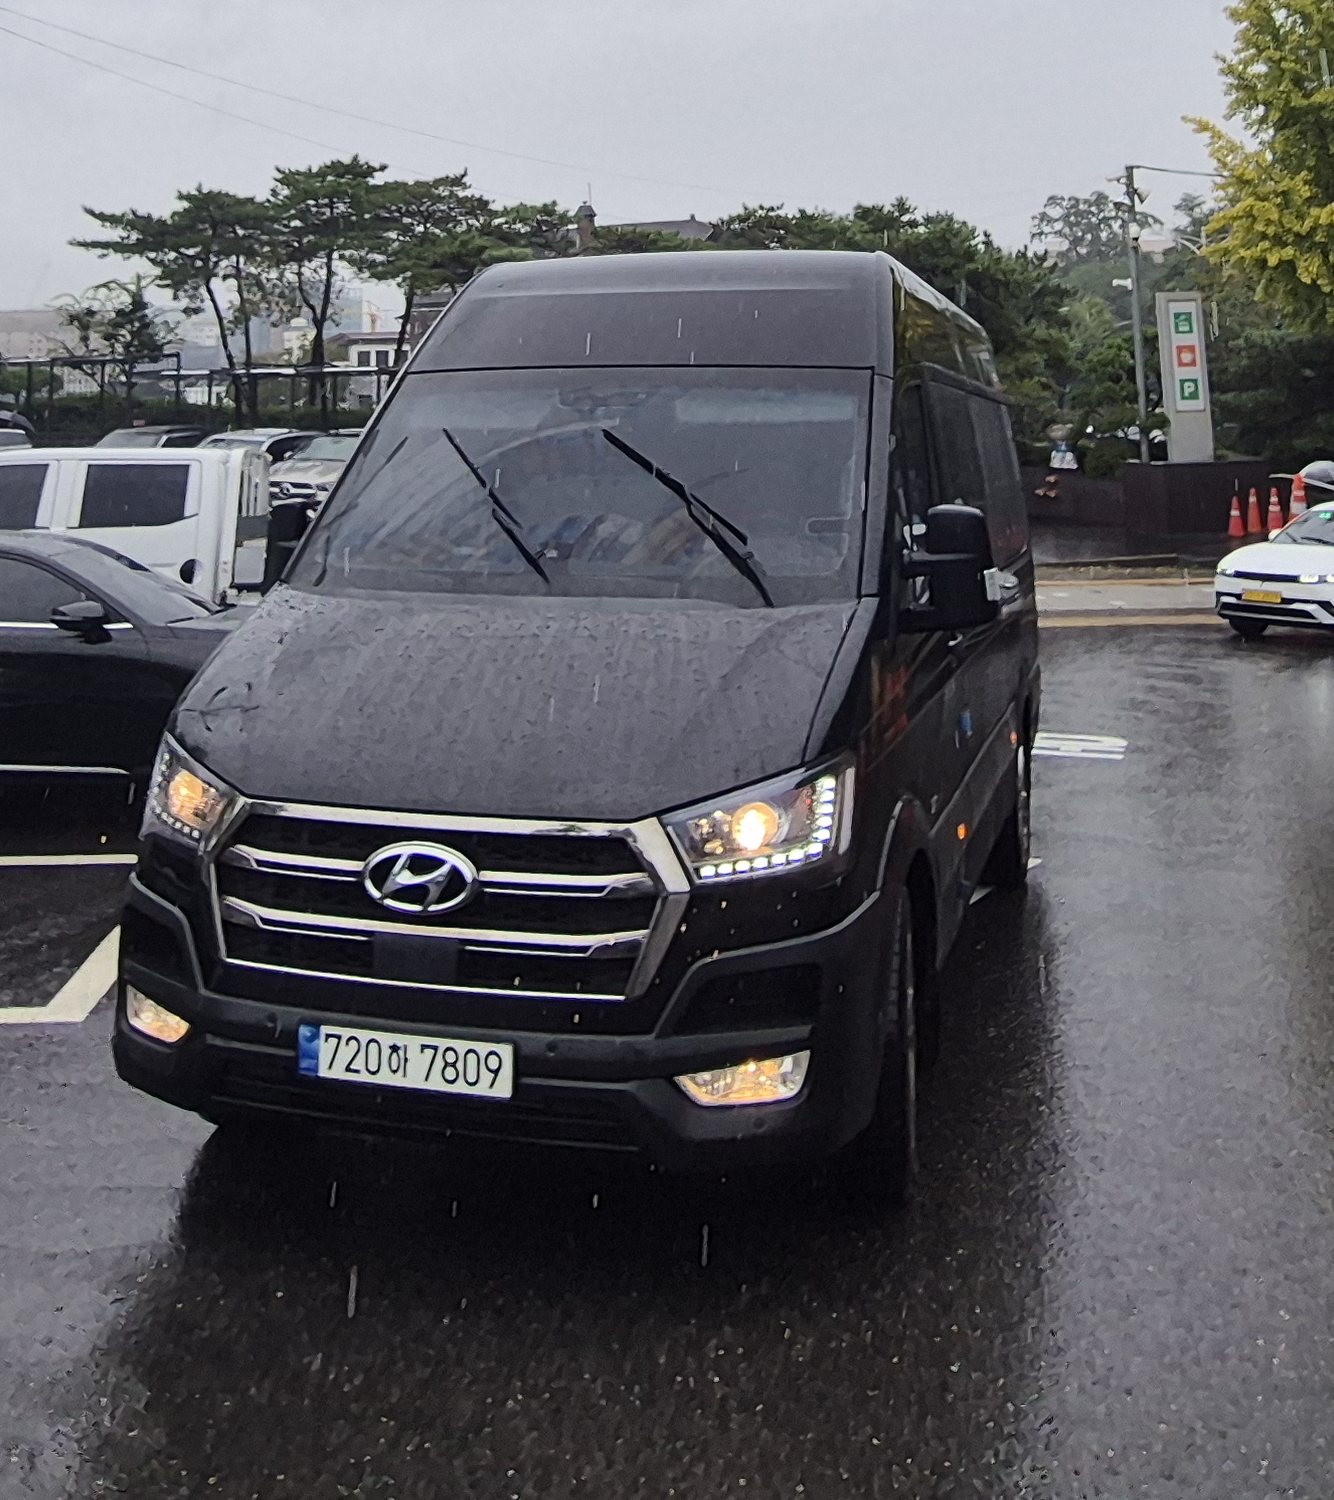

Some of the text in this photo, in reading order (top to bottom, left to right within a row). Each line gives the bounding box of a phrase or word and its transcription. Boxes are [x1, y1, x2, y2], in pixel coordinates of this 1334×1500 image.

[1183, 381, 1195, 398] P
[323, 1032, 503, 1090] 720하 7809
